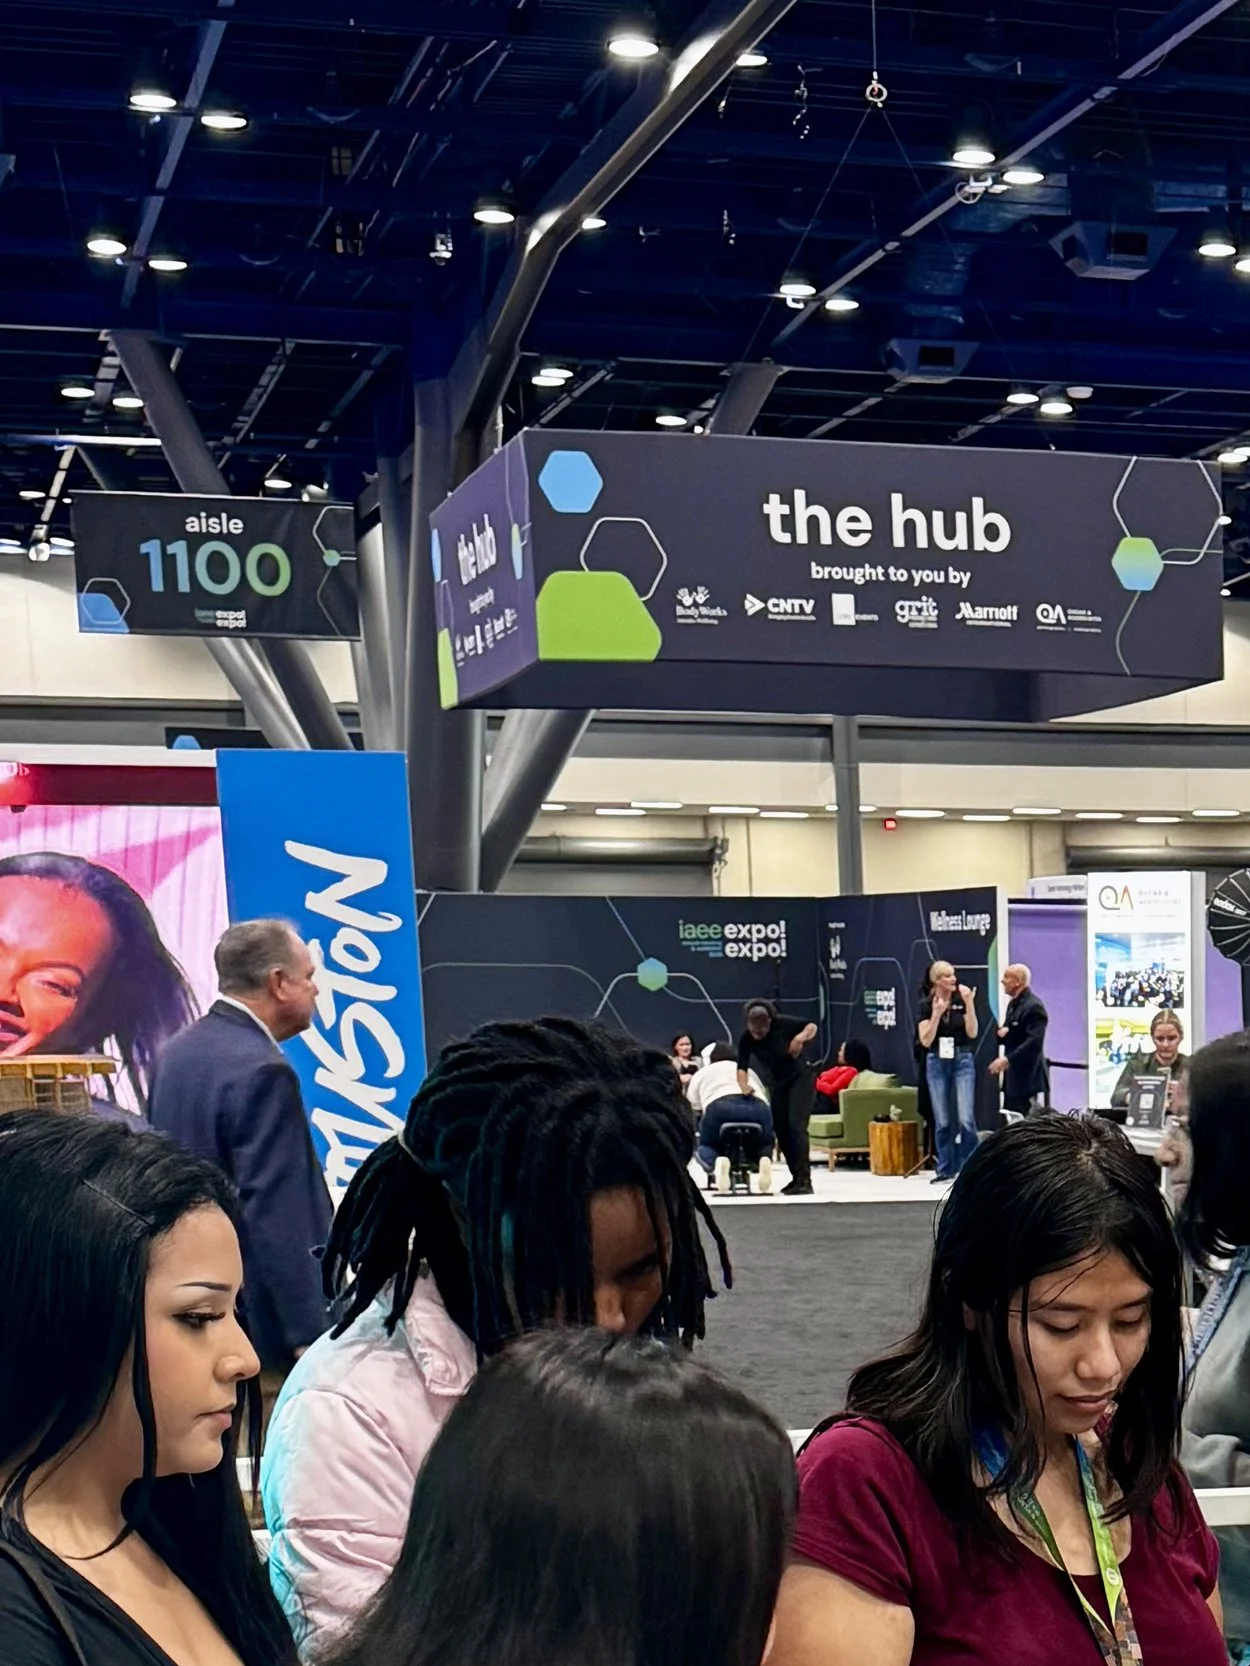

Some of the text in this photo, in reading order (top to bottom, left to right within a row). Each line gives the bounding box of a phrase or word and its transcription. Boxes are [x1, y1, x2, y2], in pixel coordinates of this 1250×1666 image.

[185, 511, 244, 534] aisle
[763, 488, 1012, 553] the hub
[139, 538, 291, 597] 1100
[811, 560, 972, 588] brought to you by
[767, 598, 815, 614] CNTV
[895, 595, 938, 623] grit
[678, 919, 786, 942] iaee expo!
[929, 909, 991, 936] Wellness Lounge
[724, 939, 788, 962] expo!
[284, 839, 406, 1200] USTON
